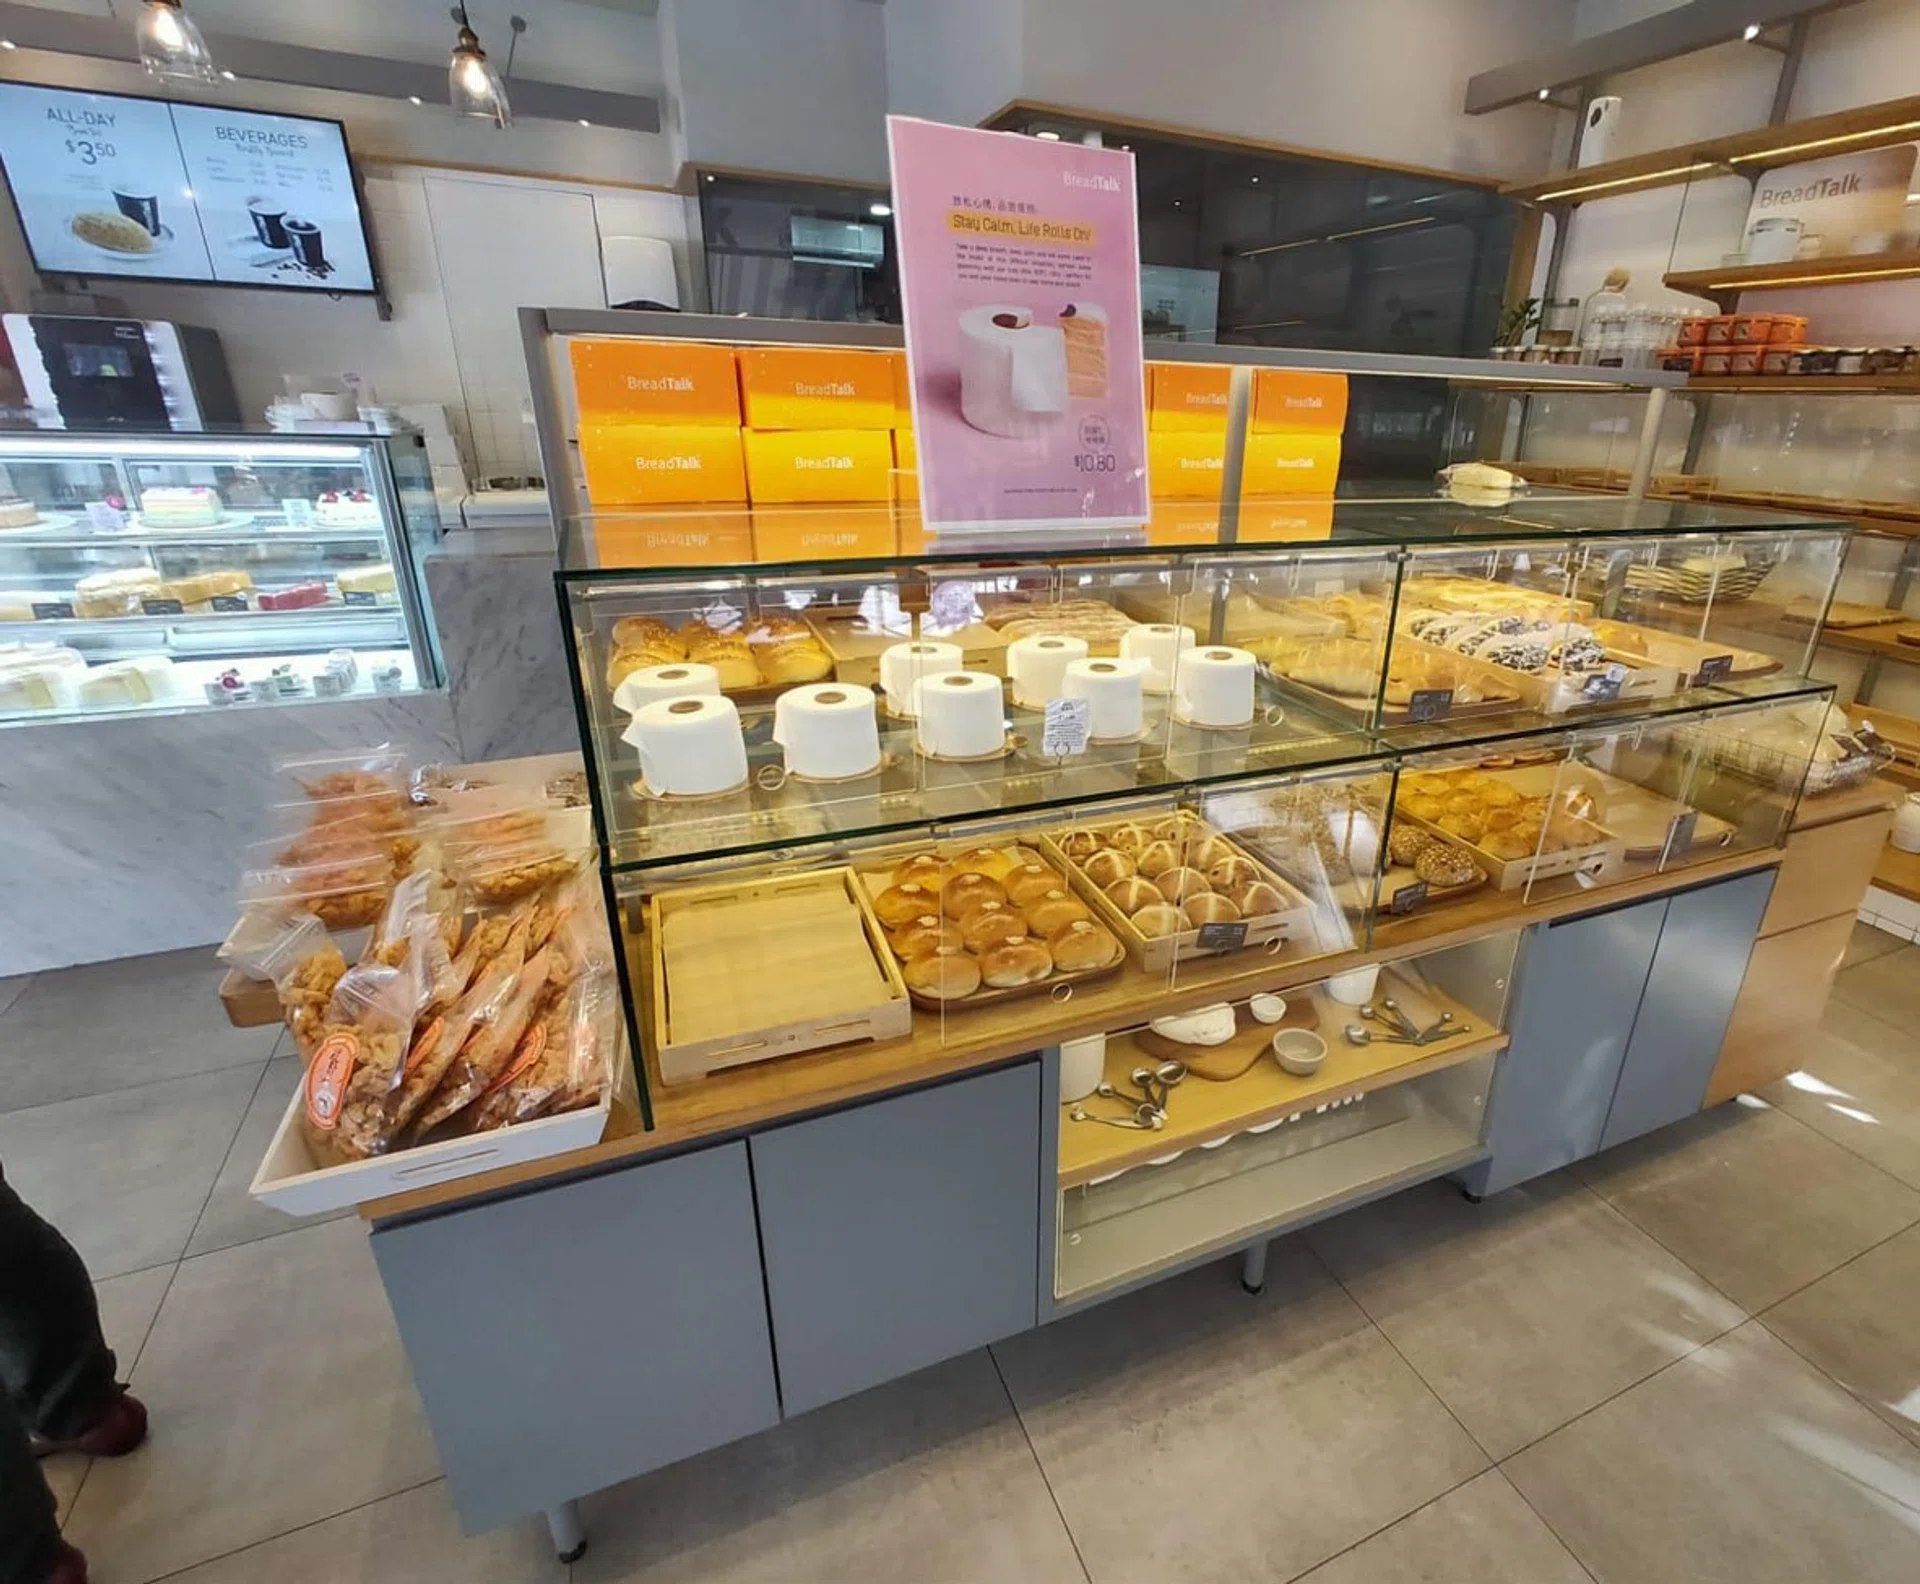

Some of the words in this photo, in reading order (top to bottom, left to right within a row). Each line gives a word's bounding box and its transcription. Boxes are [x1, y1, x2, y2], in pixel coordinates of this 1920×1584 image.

[47, 106, 116, 127] ALL-DAY
[215, 126, 308, 149] BEVERAGES
[1063, 171, 1121, 192] BreadTalk
[1760, 174, 1862, 208] BreadTalk
[953, 214, 980, 231] Stay
[983, 217, 1016, 235] Calm,
[1019, 220, 1040, 237] Life
[1043, 223, 1071, 239] Rolls
[627, 375, 694, 392] BreadTalk
[795, 382, 855, 396] BreadTalk
[636, 456, 702, 470] BreadTalk
[795, 456, 854, 469] BreadTalk
